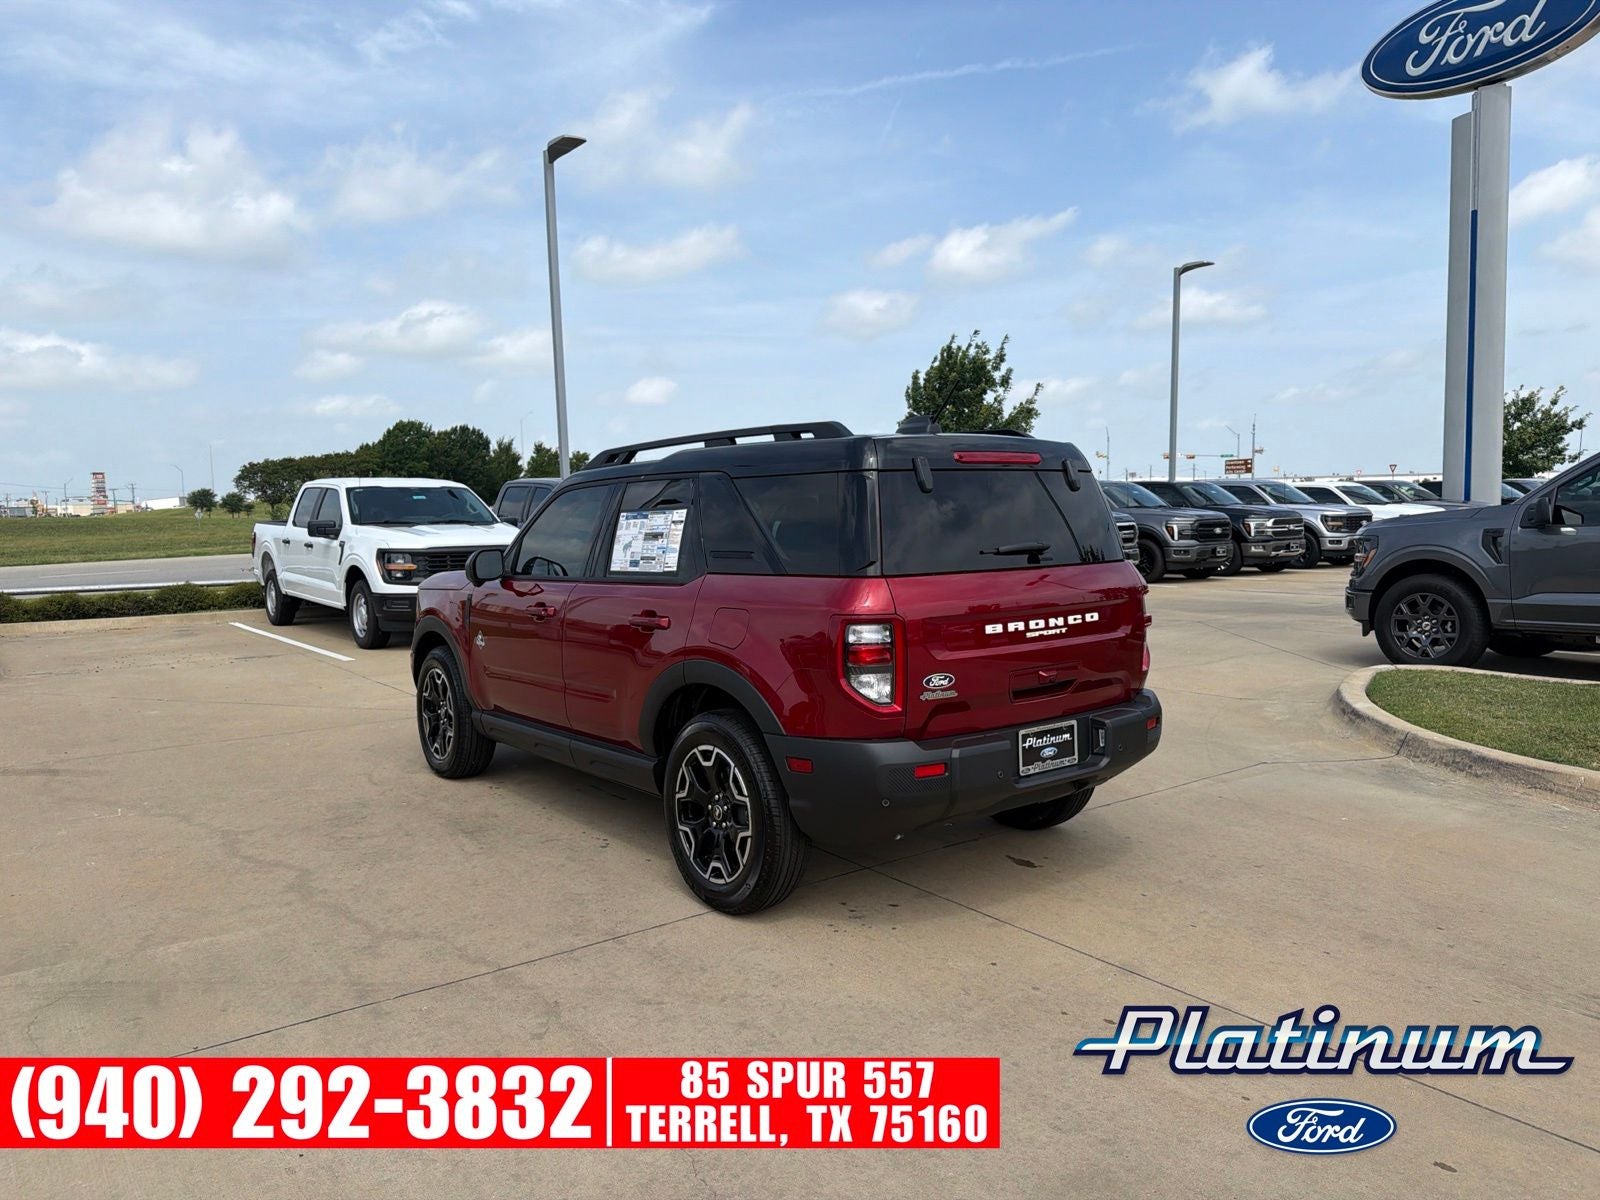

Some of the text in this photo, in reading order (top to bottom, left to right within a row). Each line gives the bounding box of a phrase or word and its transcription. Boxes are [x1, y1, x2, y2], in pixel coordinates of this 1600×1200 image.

[1405, 0, 1546, 77] Ford
[985, 612, 1099, 634] BRONCO
[1026, 627, 1068, 638] SPORT
[929, 675, 950, 687] Ford
[920, 690, 958, 701] Platinum
[1022, 733, 1073, 749] Platinum
[1032, 759, 1067, 772] Platinum
